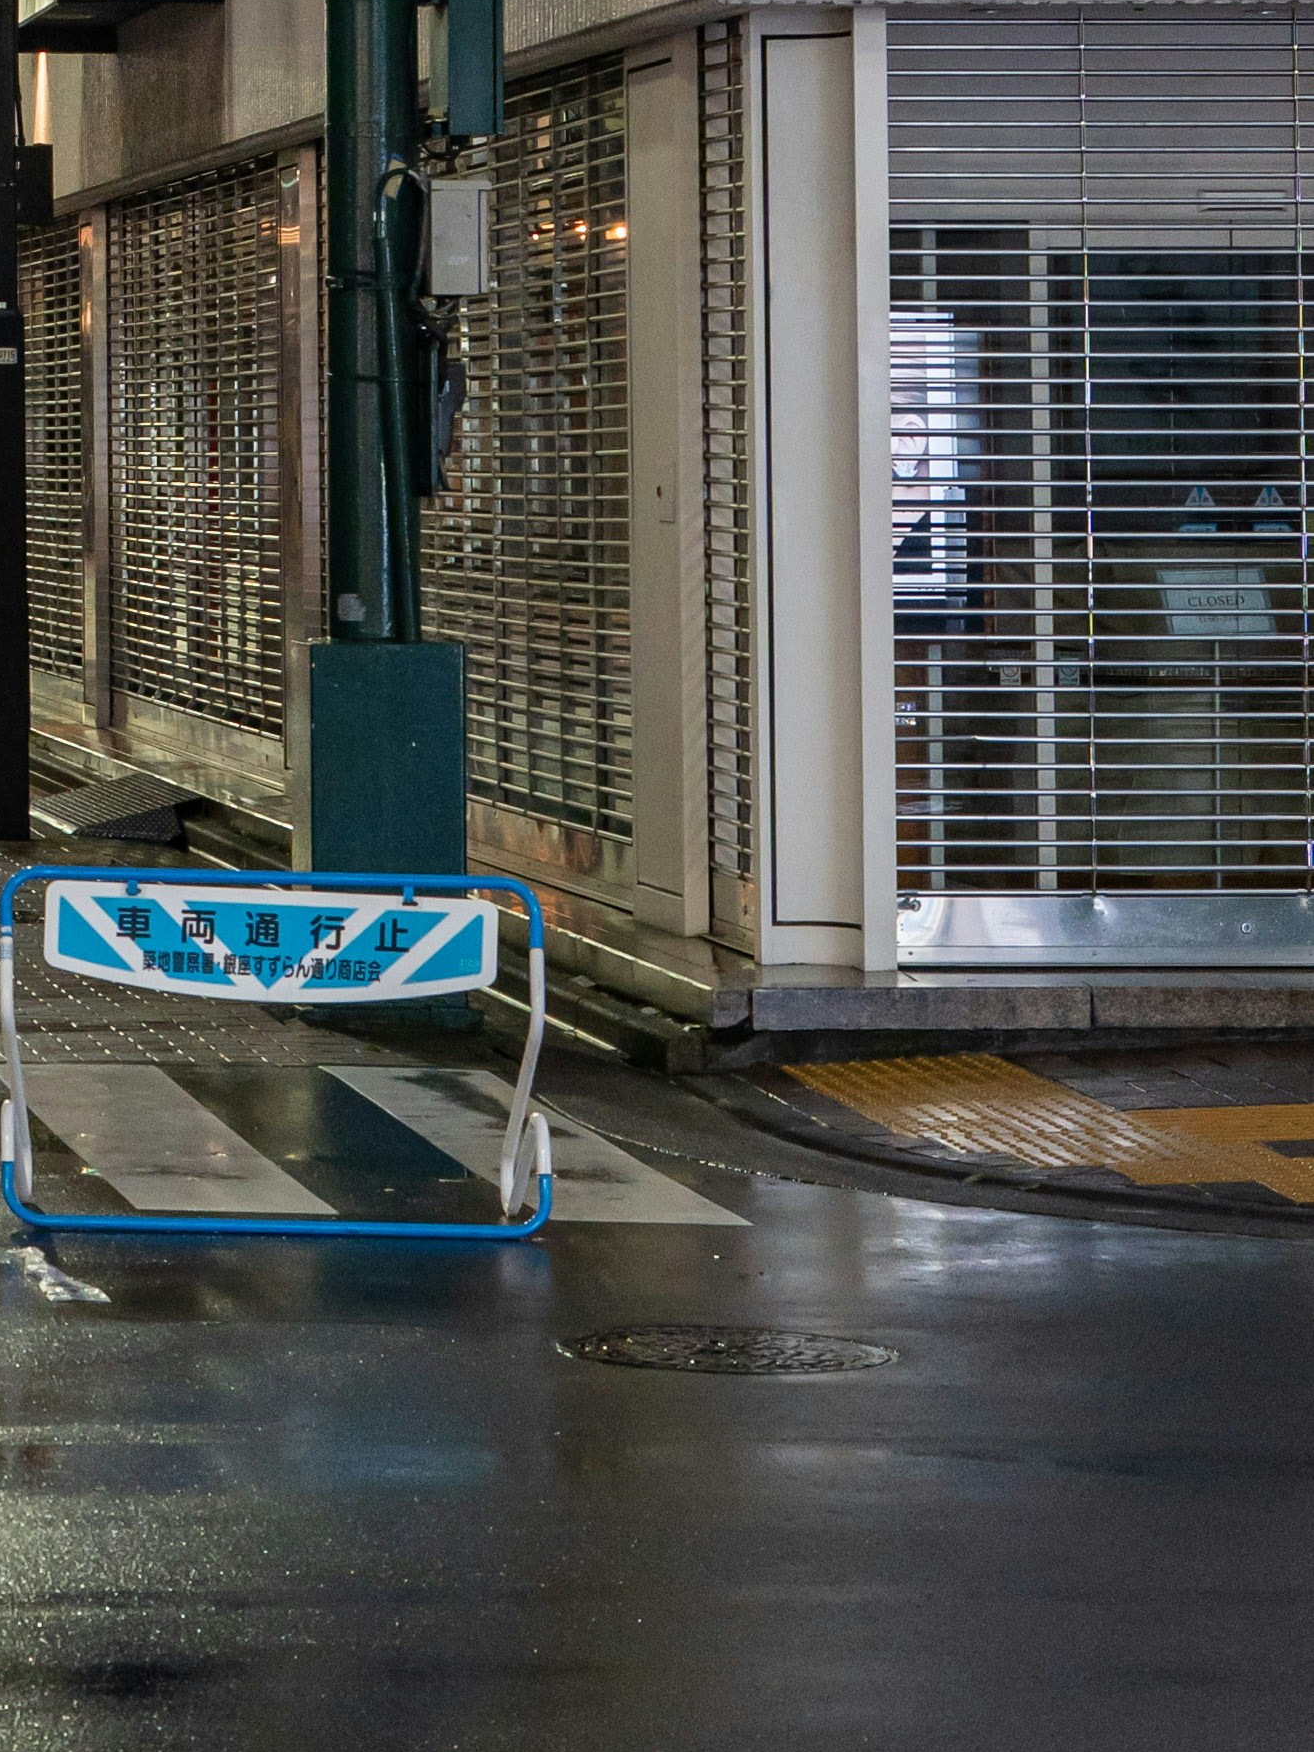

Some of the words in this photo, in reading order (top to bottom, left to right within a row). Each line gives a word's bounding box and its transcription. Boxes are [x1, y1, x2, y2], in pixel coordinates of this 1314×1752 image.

[1187, 595, 1245, 608] CLOSED
[116, 906, 410, 953] 車両通行止
